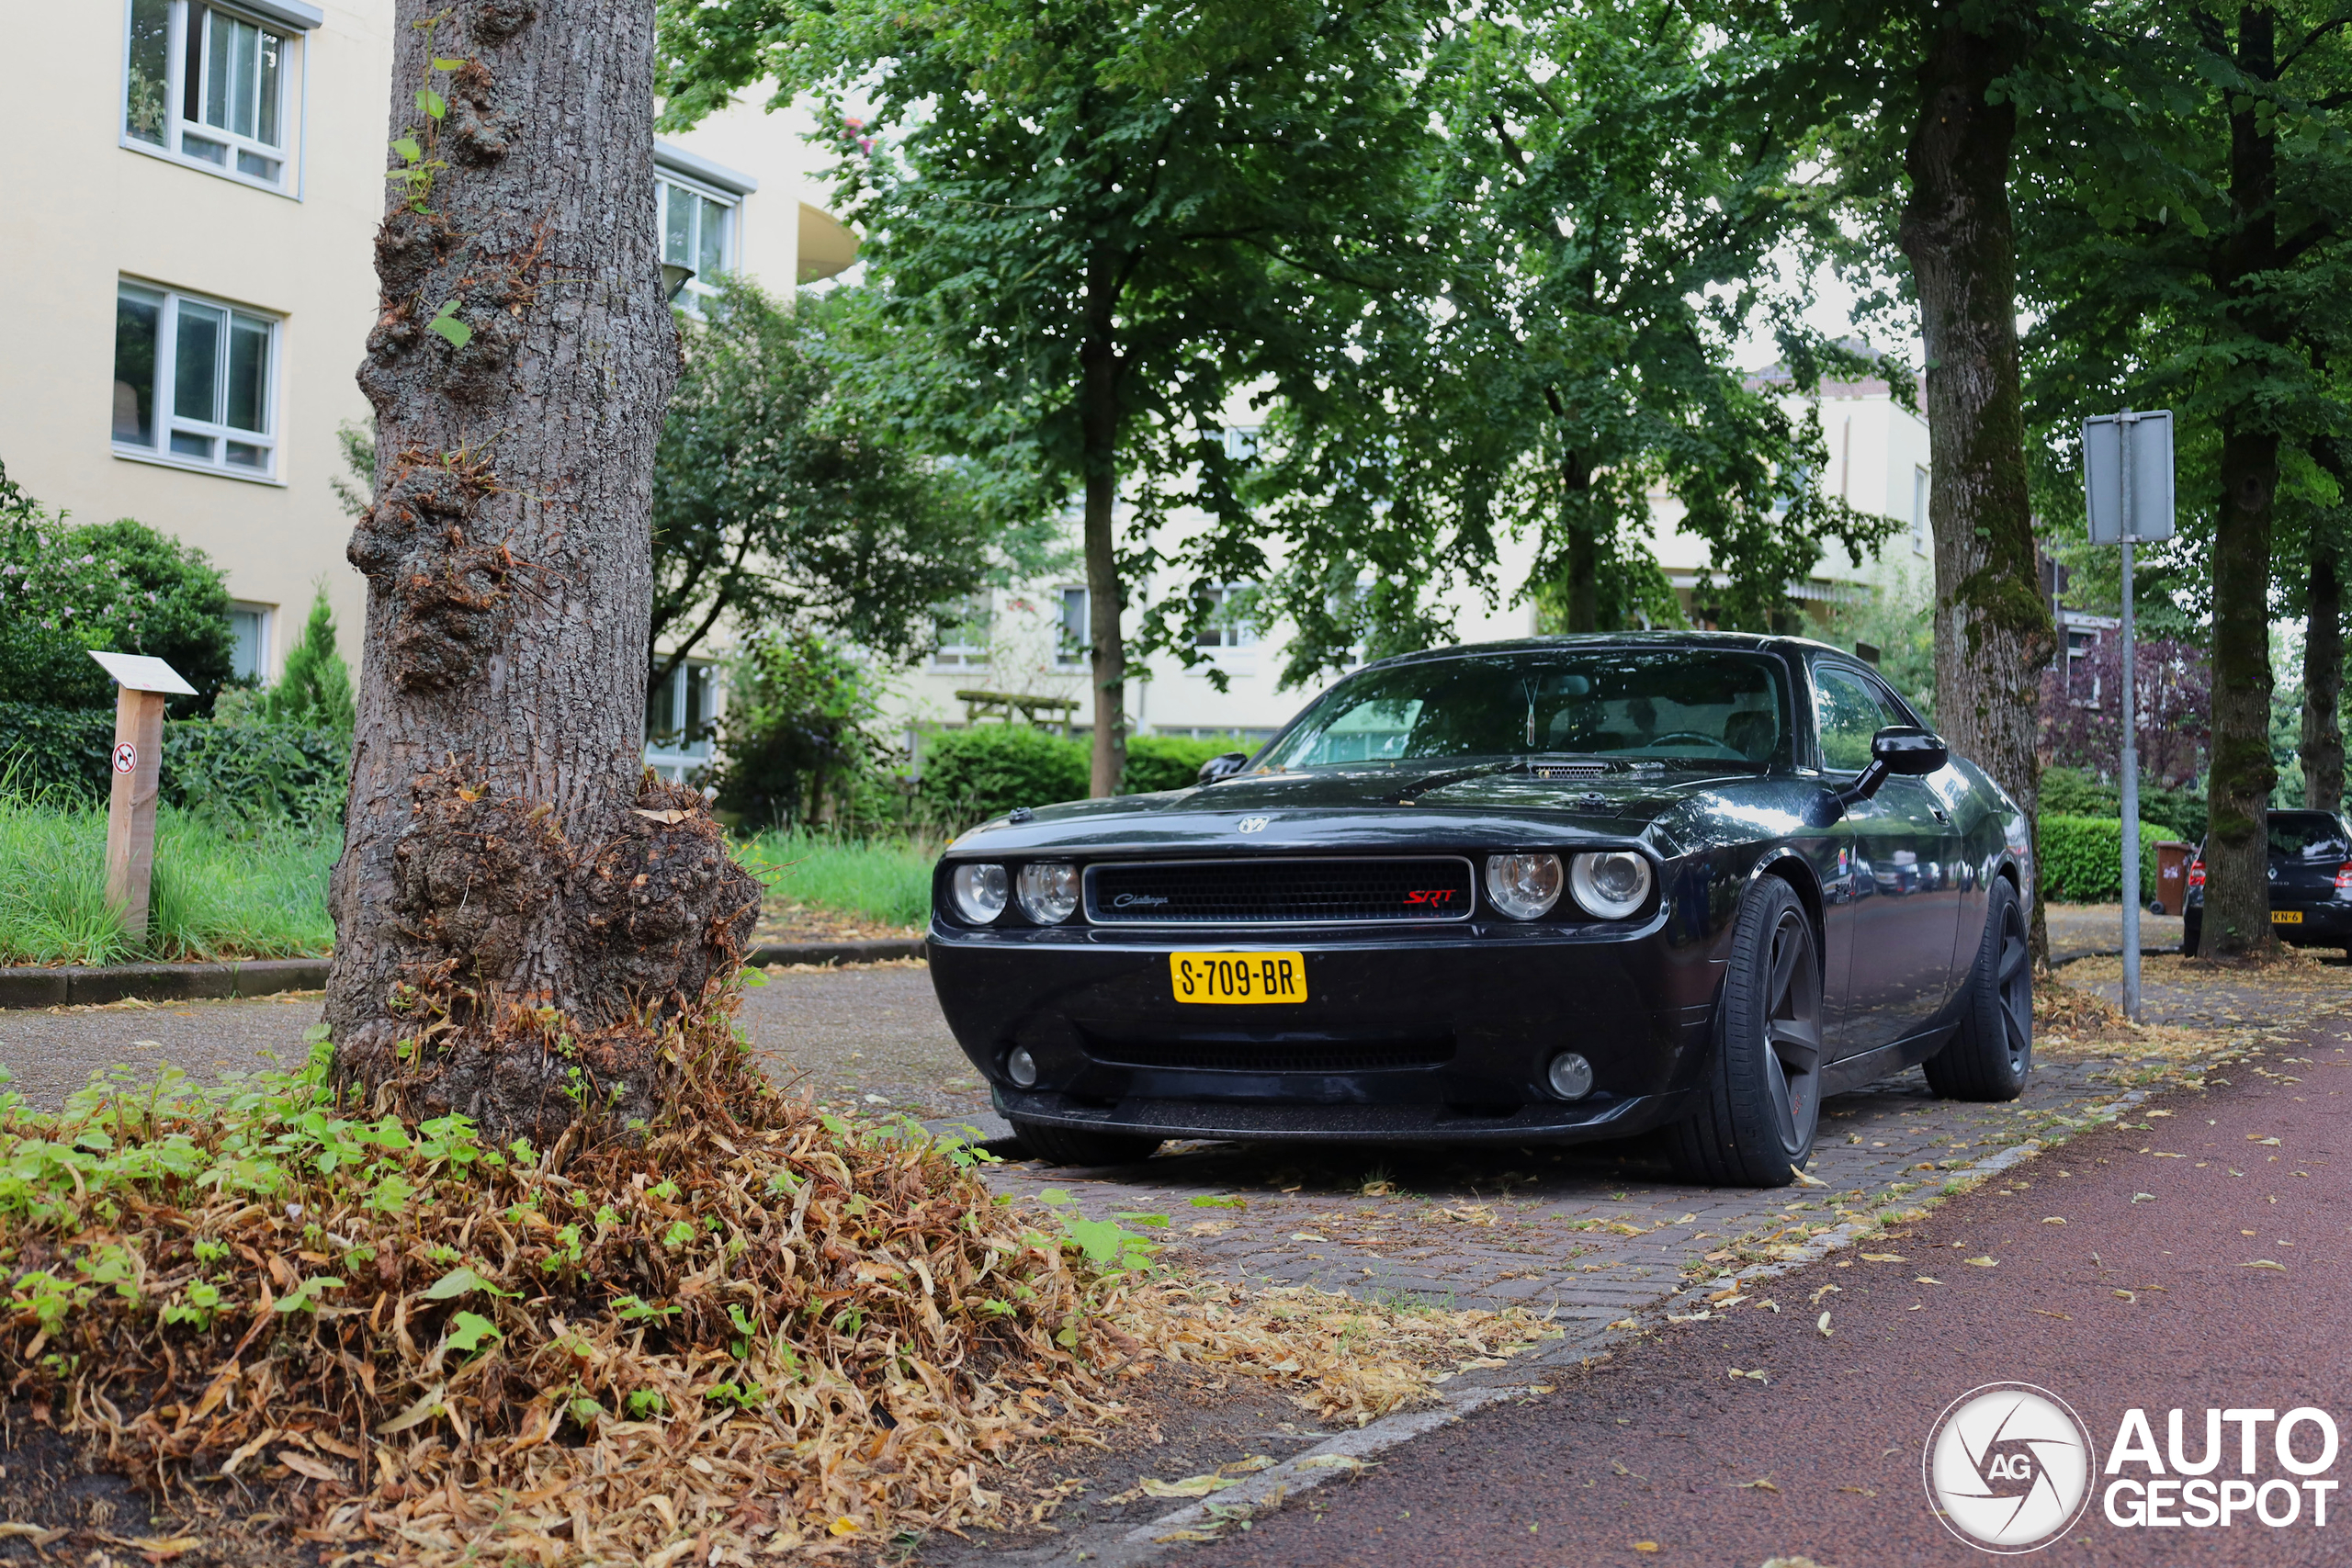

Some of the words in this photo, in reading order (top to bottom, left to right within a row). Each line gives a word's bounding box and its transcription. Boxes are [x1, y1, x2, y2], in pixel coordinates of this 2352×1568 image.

[1114, 893, 1169, 908] Challenger
[1403, 889, 1457, 908] SRT
[2271, 912, 2299, 921] KN-6
[1181, 959, 1295, 996] S-709-BR
